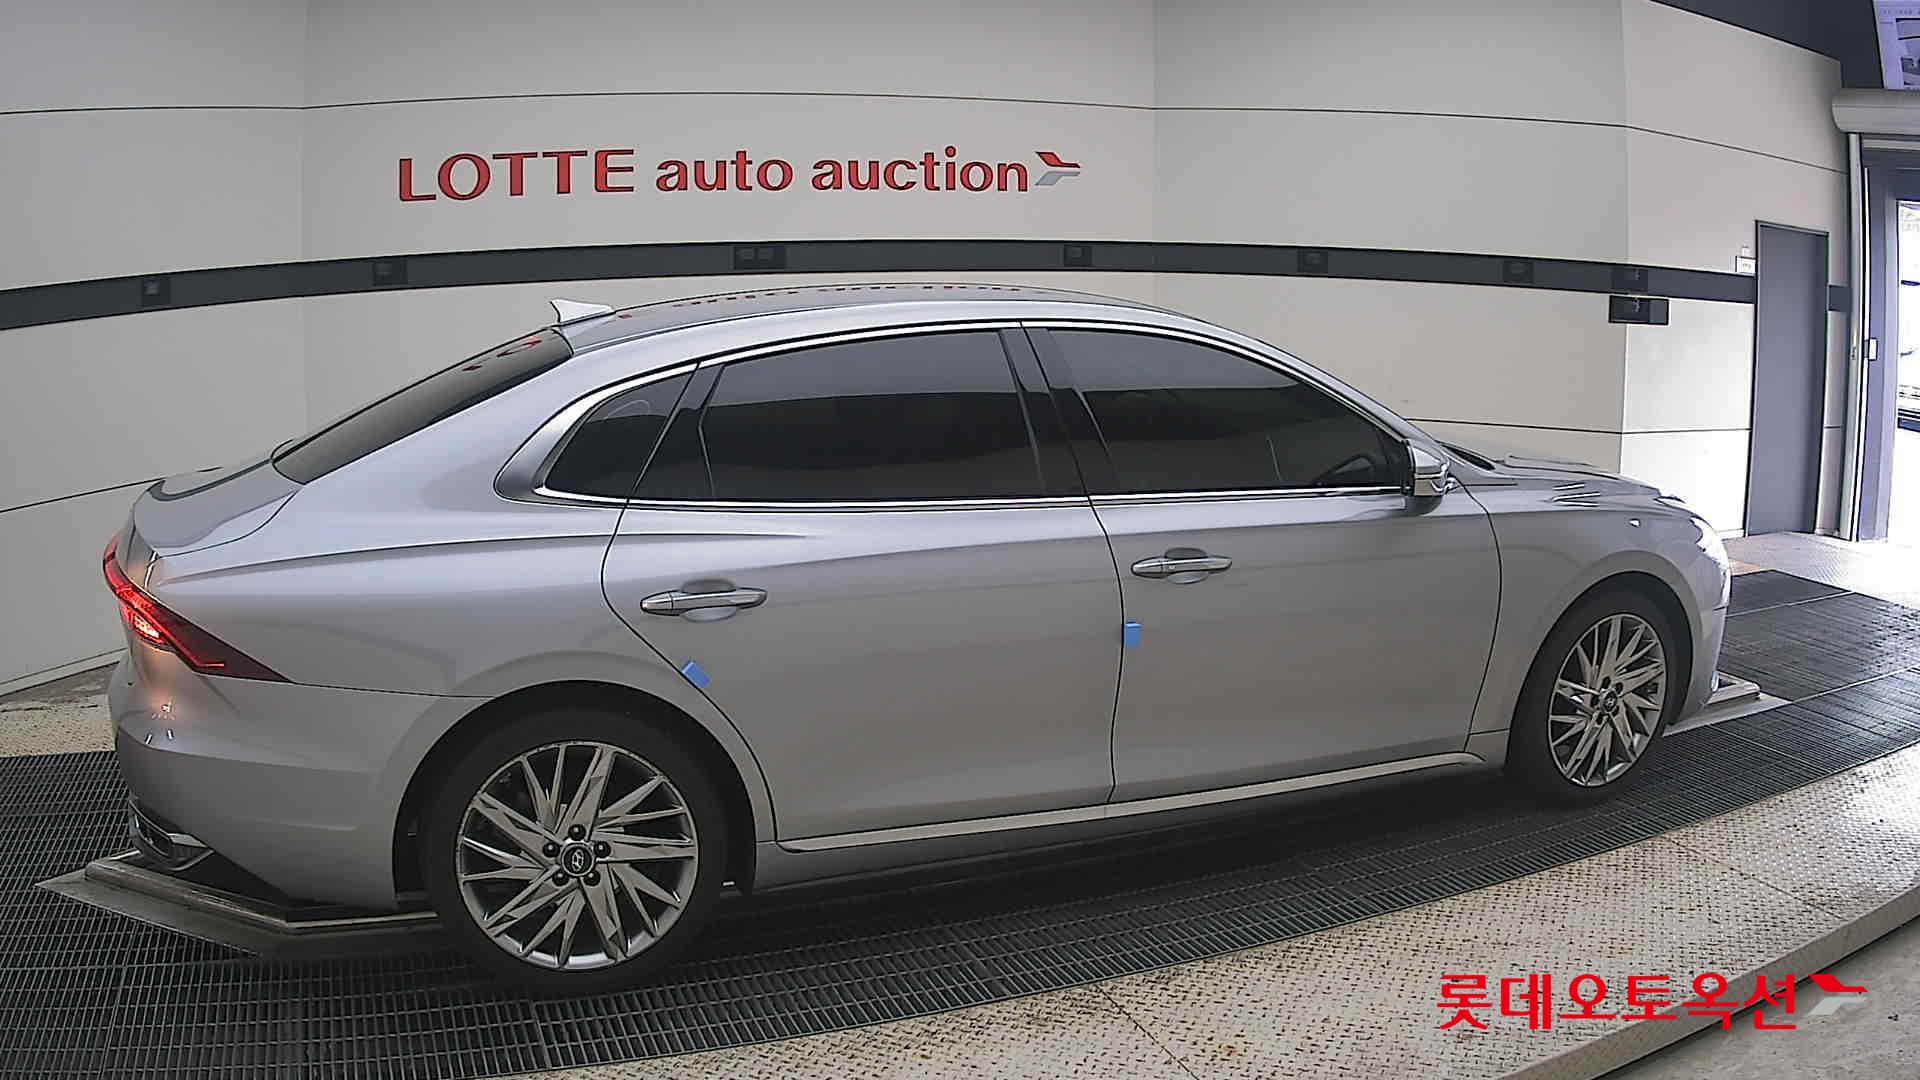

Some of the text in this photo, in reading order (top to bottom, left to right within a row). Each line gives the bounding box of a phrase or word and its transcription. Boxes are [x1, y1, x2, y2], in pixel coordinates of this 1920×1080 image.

[398, 145, 1030, 203] LOTTE auto auction
